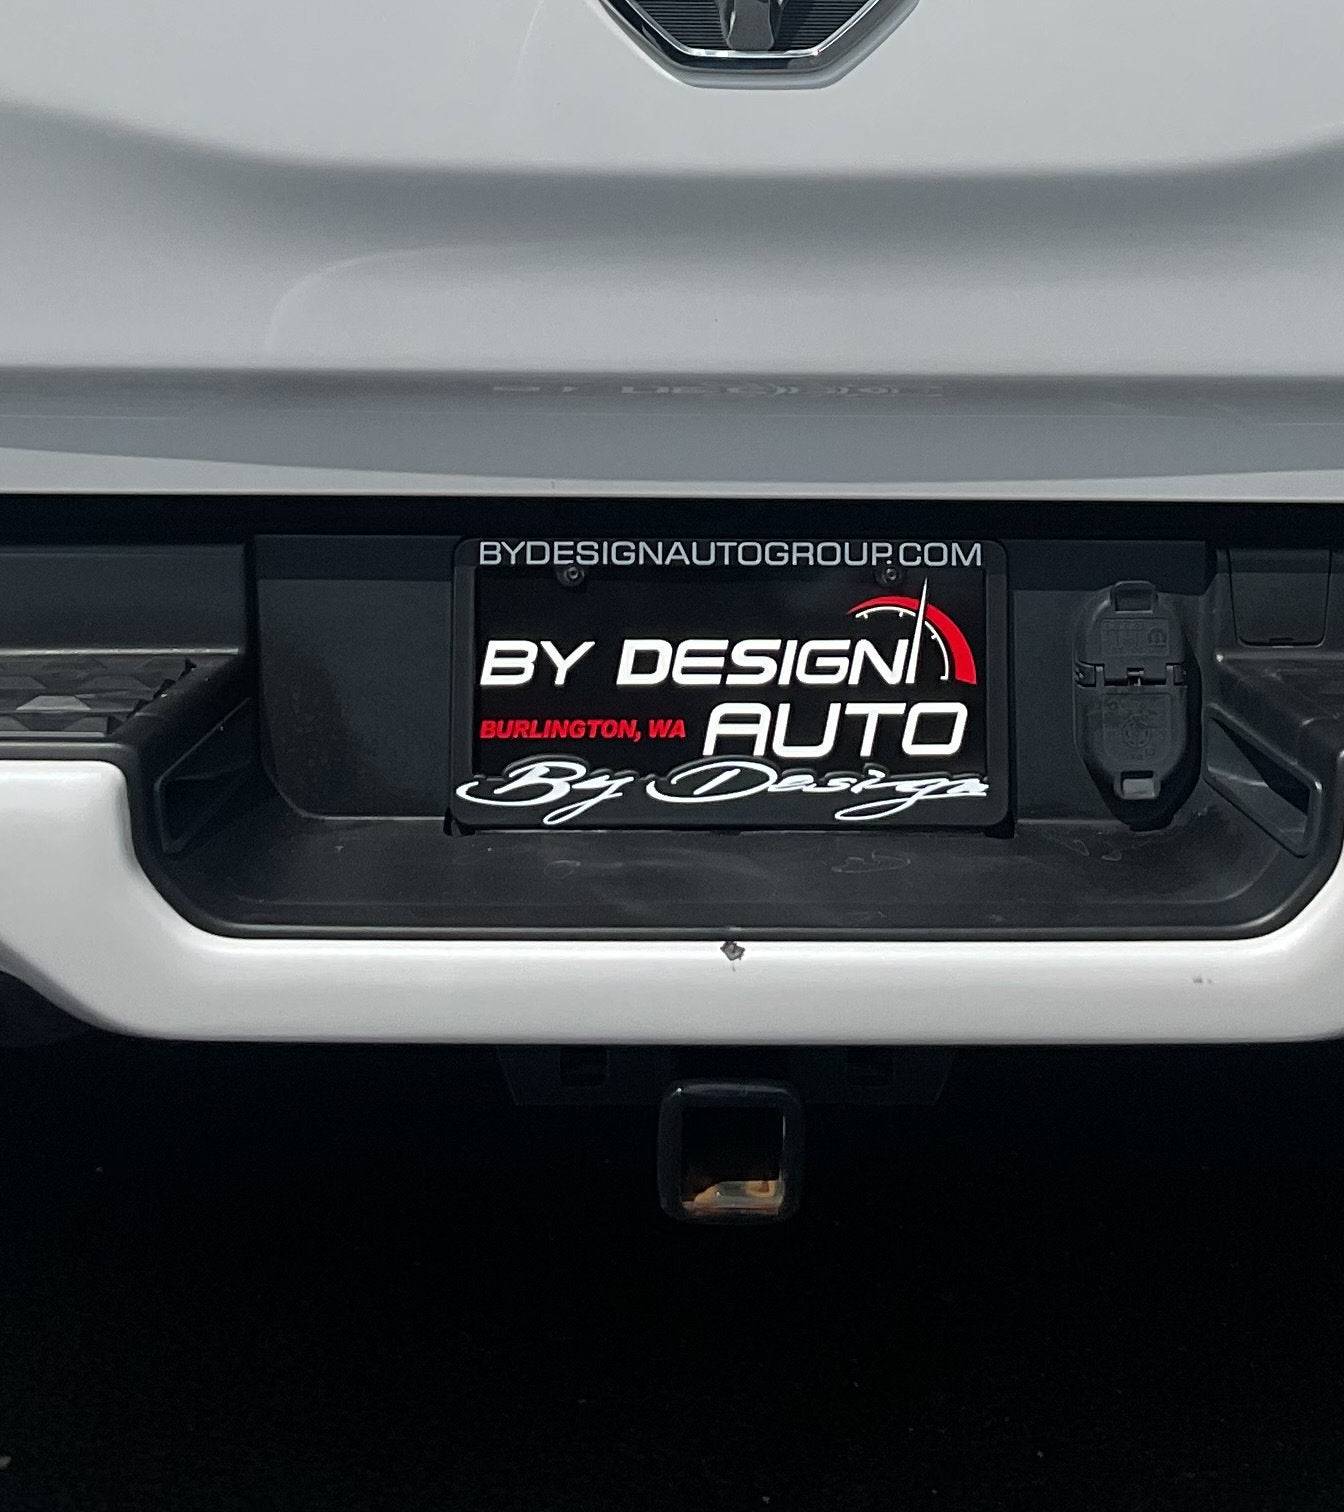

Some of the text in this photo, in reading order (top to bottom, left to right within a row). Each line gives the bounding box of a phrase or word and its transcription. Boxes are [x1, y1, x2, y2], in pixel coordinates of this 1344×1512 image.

[479, 541, 983, 566] BYDESIGNAUTOGROUP.COM
[480, 639, 909, 686] BY DESIGN
[480, 719, 687, 743] BURLINGTON, WA
[702, 701, 968, 758] AUTO
[456, 761, 989, 825] By Design
